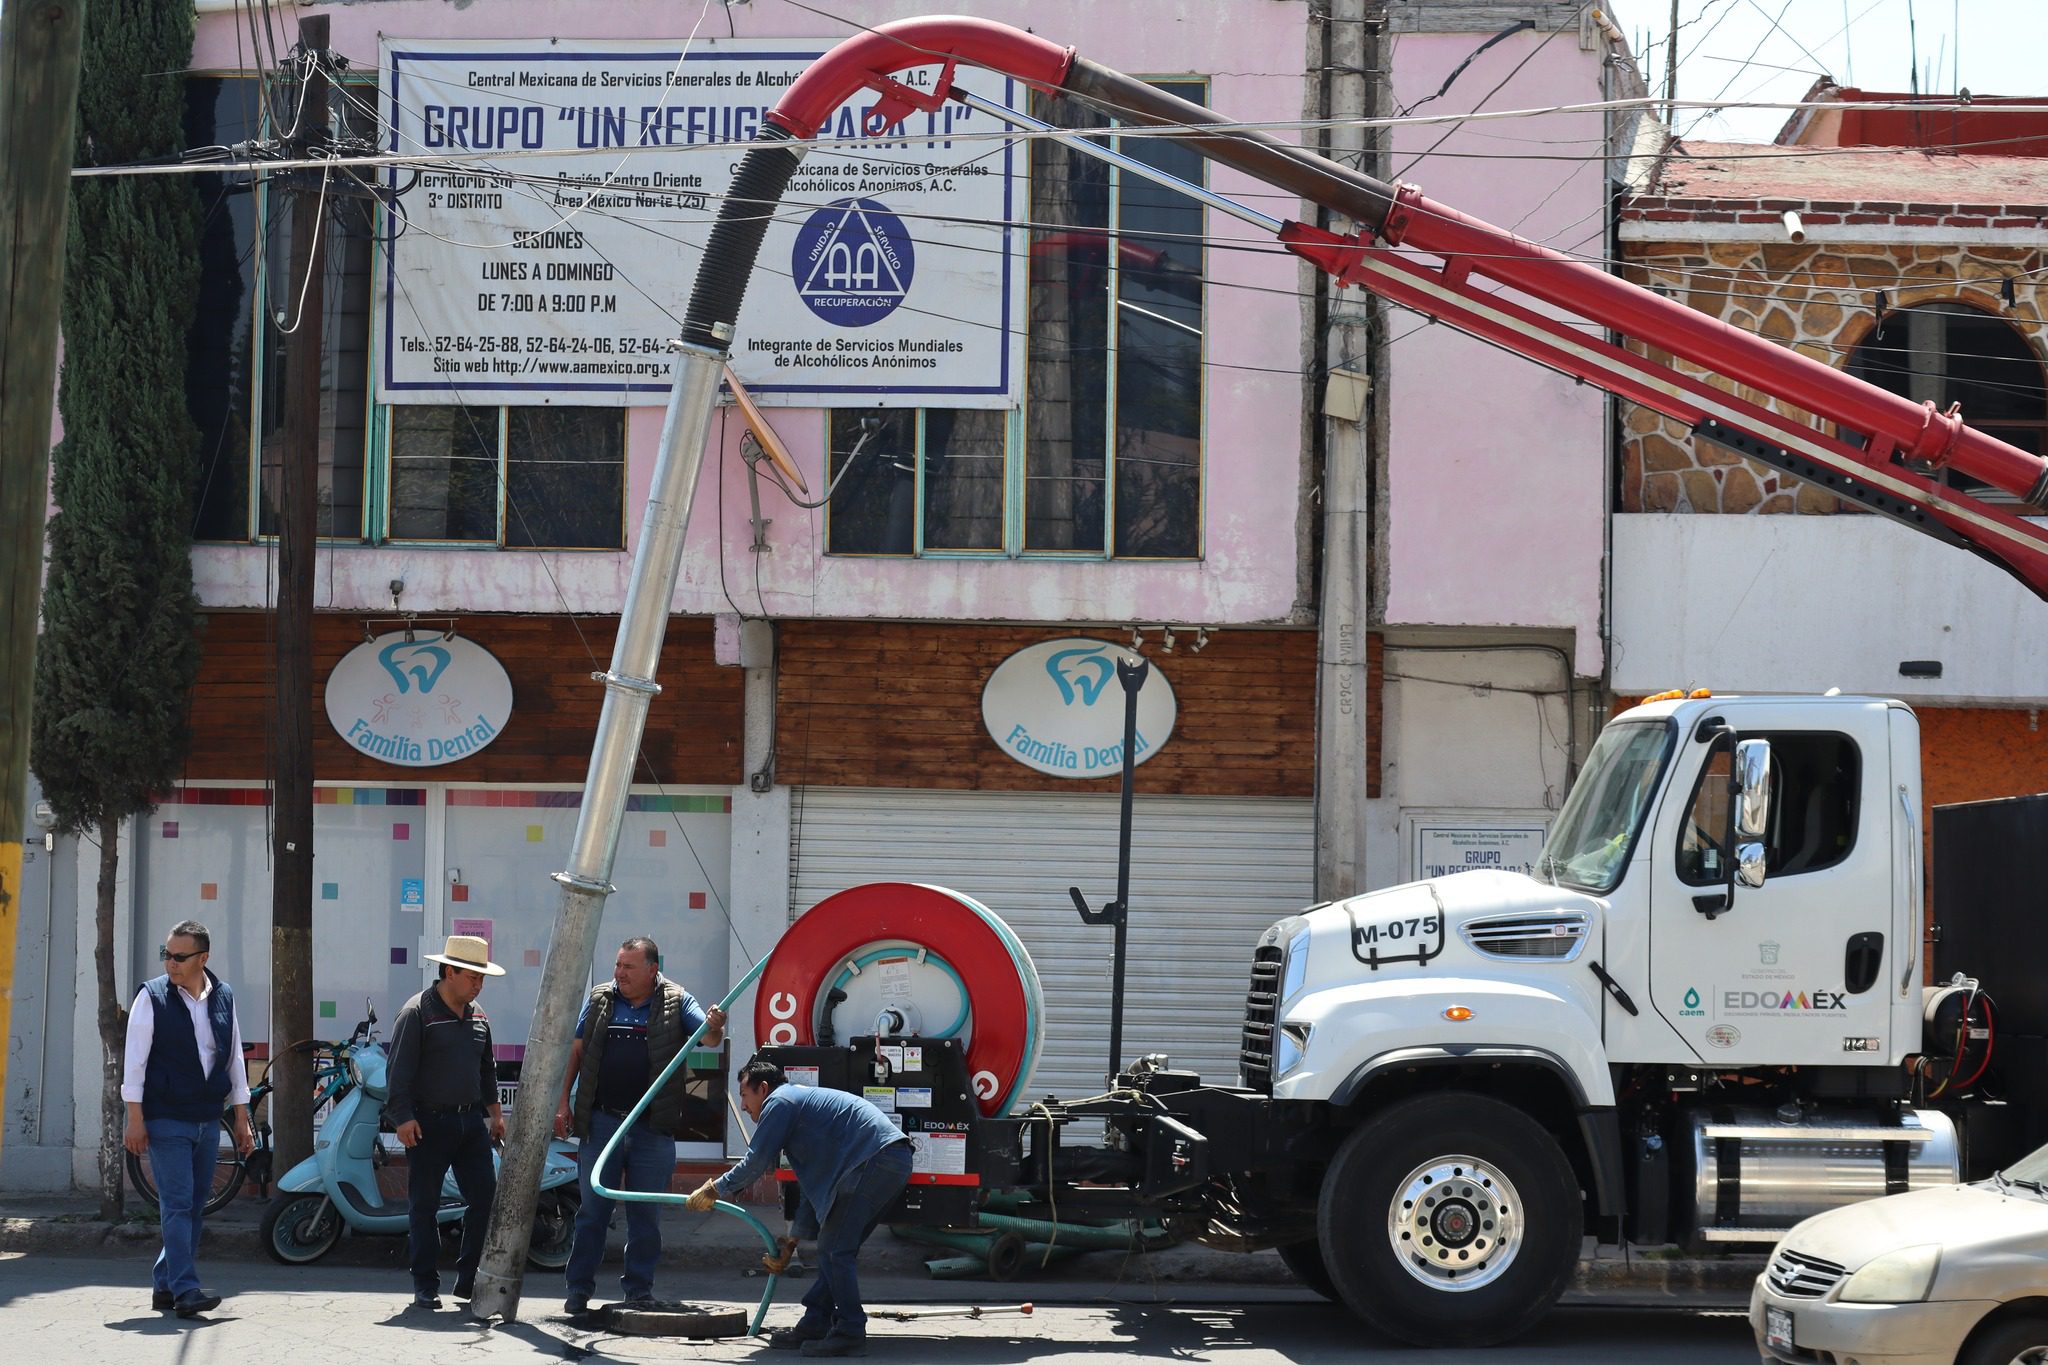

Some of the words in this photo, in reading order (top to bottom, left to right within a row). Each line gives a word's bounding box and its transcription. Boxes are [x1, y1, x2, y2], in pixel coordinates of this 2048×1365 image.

[468, 71, 515, 87] Central
[519, 71, 578, 87] Mexicana
[581, 71, 597, 87] de
[601, 71, 662, 87] Servicios
[666, 71, 731, 87] Generales
[736, 71, 751, 87] de
[755, 71, 804, 87] Alcohó
[906, 70, 931, 86] A.C.
[424, 105, 544, 149] GRUPO
[640, 106, 769, 146] REFUG
[789, 163, 840, 177] exicana
[843, 163, 858, 177] de
[863, 163, 921, 177] Servicios
[925, 163, 988, 176] Generales
[416, 171, 485, 189] Territorio
[605, 171, 649, 187] Centro
[653, 171, 702, 188] Oriente
[930, 179, 957, 192] A.C.
[447, 193, 502, 209] DISTRITO
[553, 189, 583, 208] Área
[587, 190, 631, 208] México
[635, 192, 673, 208] Norte
[677, 193, 706, 210] (25)
[513, 231, 583, 249] SESIONES
[808, 221, 836, 262] UNIDAD
[874, 225, 901, 270] SERVICIO
[482, 262, 527, 280] LUNES
[532, 262, 541, 280] A
[546, 263, 613, 281] DOMINGO
[824, 242, 879, 289] AA
[478, 294, 496, 312] DE
[501, 294, 533, 312] 7:00
[538, 295, 547, 312] A
[552, 295, 585, 313] 9:00
[591, 295, 616, 313] P.M
[814, 296, 892, 308] RECUPERACIÓN
[400, 336, 432, 352] Tels.:
[435, 336, 522, 354] 52-64-25-88,
[526, 337, 615, 355] 52-64-24-06,
[748, 338, 814, 356] Integrante
[816, 338, 832, 352] de
[835, 338, 895, 352] Servicios
[899, 338, 964, 353] Mundiales
[433, 357, 461, 373] Sitio
[465, 357, 489, 373] web
[774, 353, 791, 368] de
[793, 353, 869, 369] Alcohólicos
[872, 353, 937, 369] Anónimos
[347, 717, 421, 762] Familia
[428, 713, 496, 761] Dental
[1006, 723, 1077, 769] Familia
[1084, 728, 1149, 769] Denl
[1465, 851, 1501, 864] GRUPO
[1357, 915, 1439, 945] M-075
[1724, 989, 1847, 1010] EDOMÉX
[1679, 1009, 1705, 1017] caem
